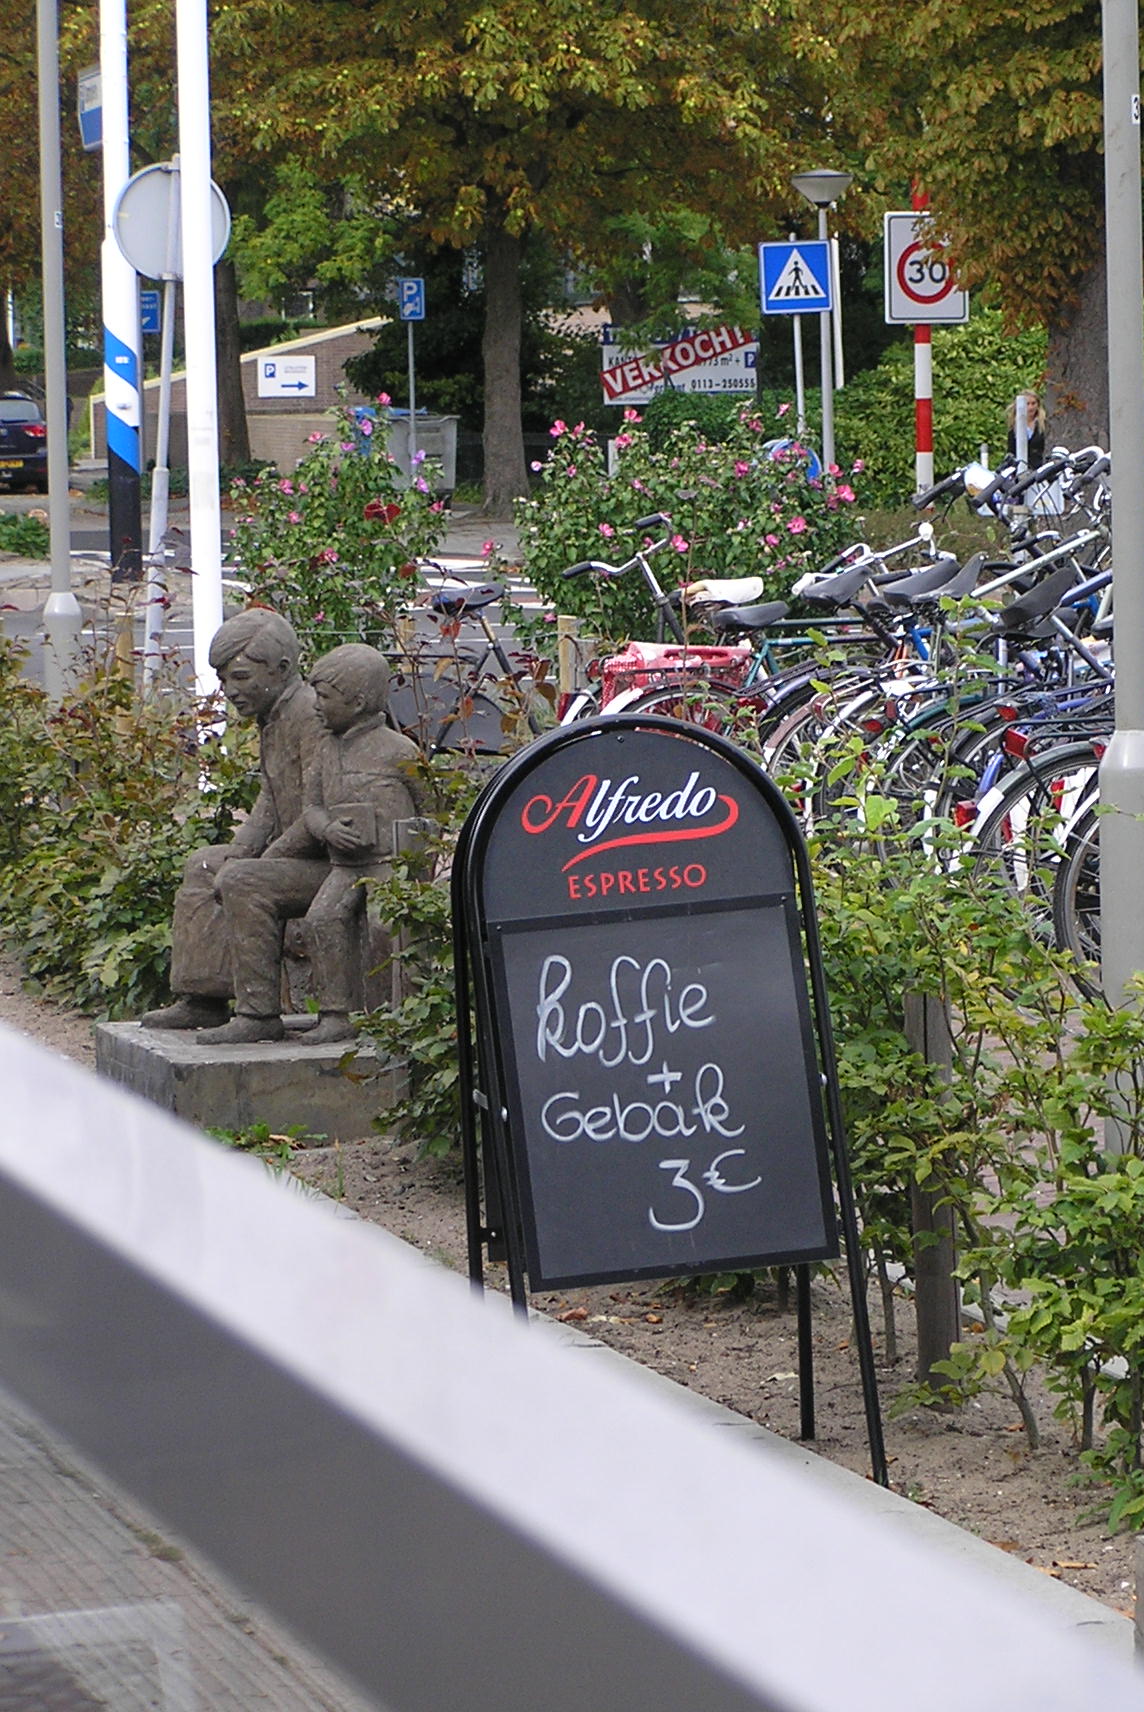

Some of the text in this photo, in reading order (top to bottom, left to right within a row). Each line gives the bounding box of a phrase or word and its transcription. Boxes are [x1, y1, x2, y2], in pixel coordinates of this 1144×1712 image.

[908, 259, 948, 284] 30
[521, 771, 718, 843] Alfredo
[568, 863, 707, 899] ESPRESSO
[647, 1061, 683, 1095] +
[541, 1063, 746, 1142] Gebak
